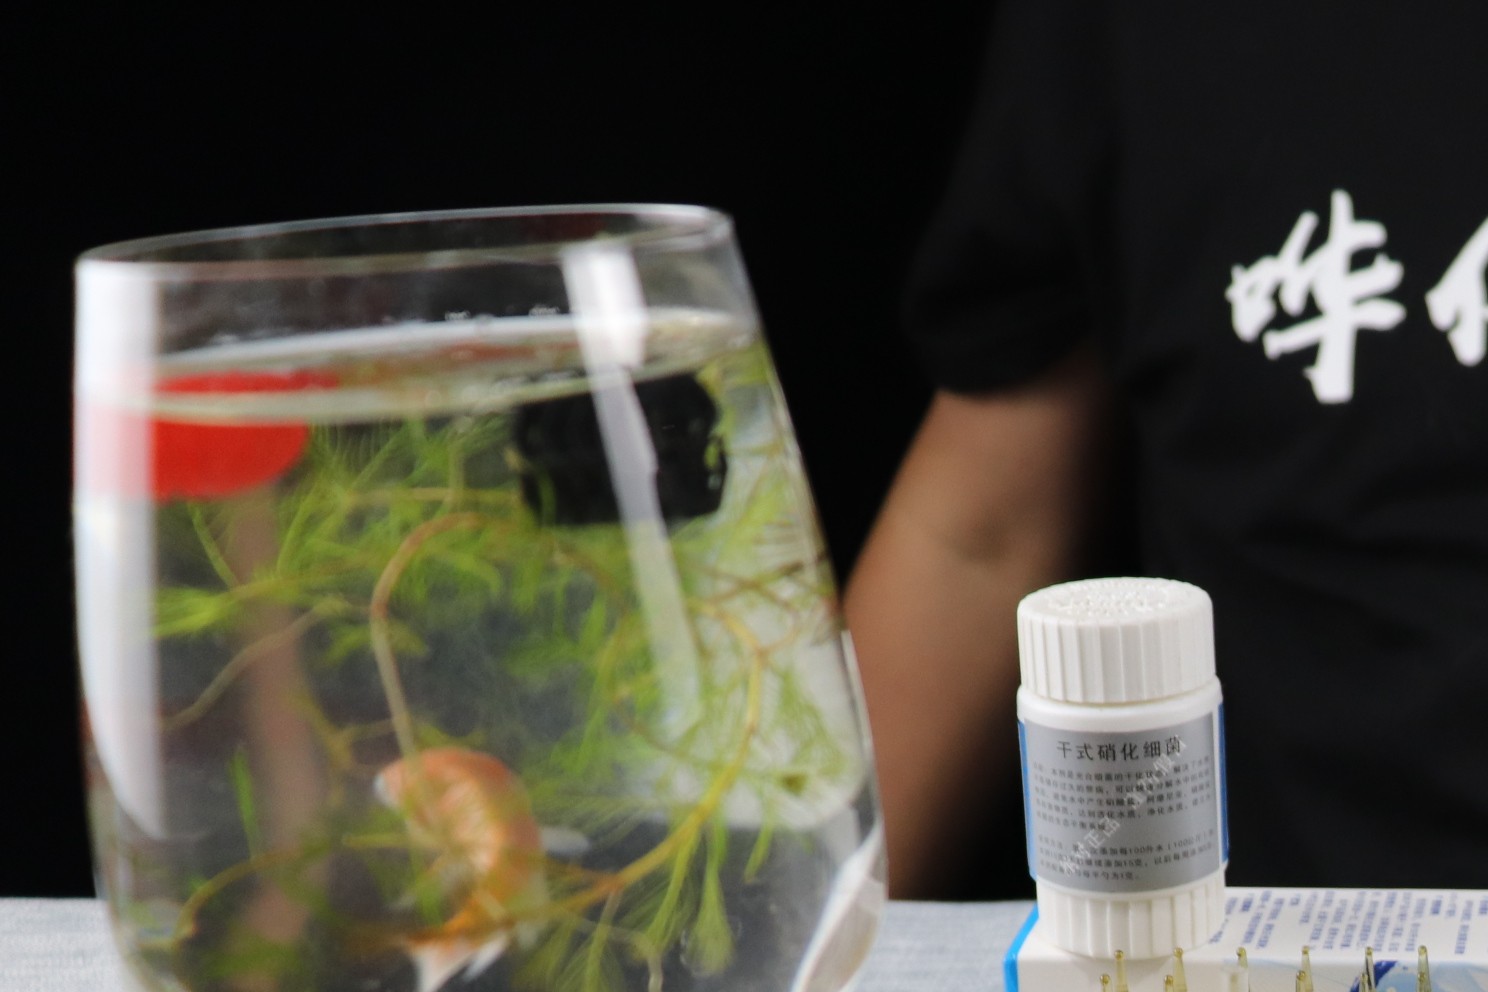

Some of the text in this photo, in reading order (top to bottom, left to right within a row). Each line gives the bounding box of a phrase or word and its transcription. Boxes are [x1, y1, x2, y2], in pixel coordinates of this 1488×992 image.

[1057, 735, 1182, 762] 干式硝化细菌
